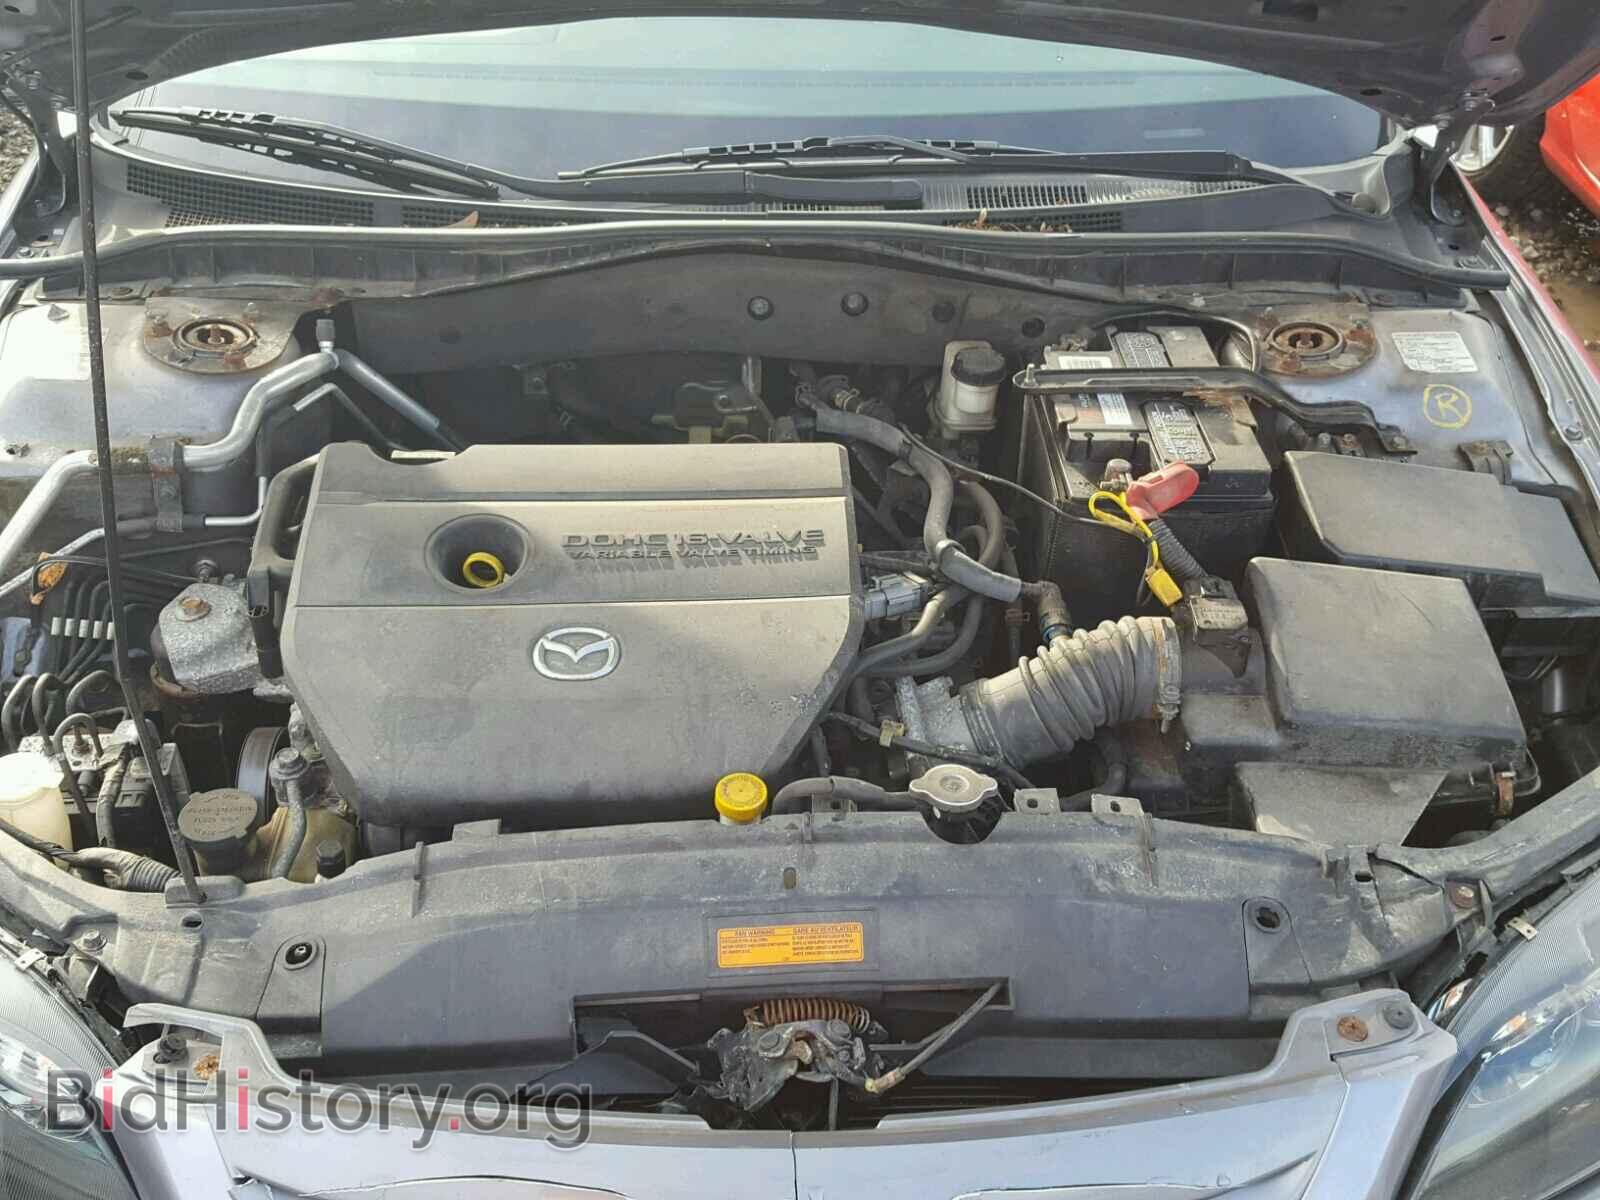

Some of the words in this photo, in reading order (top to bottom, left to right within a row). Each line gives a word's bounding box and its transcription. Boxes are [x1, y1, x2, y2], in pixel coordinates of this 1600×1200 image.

[561, 533, 669, 547] DOHC
[672, 529, 825, 546] 16-VALVE
[568, 550, 673, 560] VARIABLE
[675, 548, 739, 558] VALVE
[744, 546, 817, 556] TIMING
